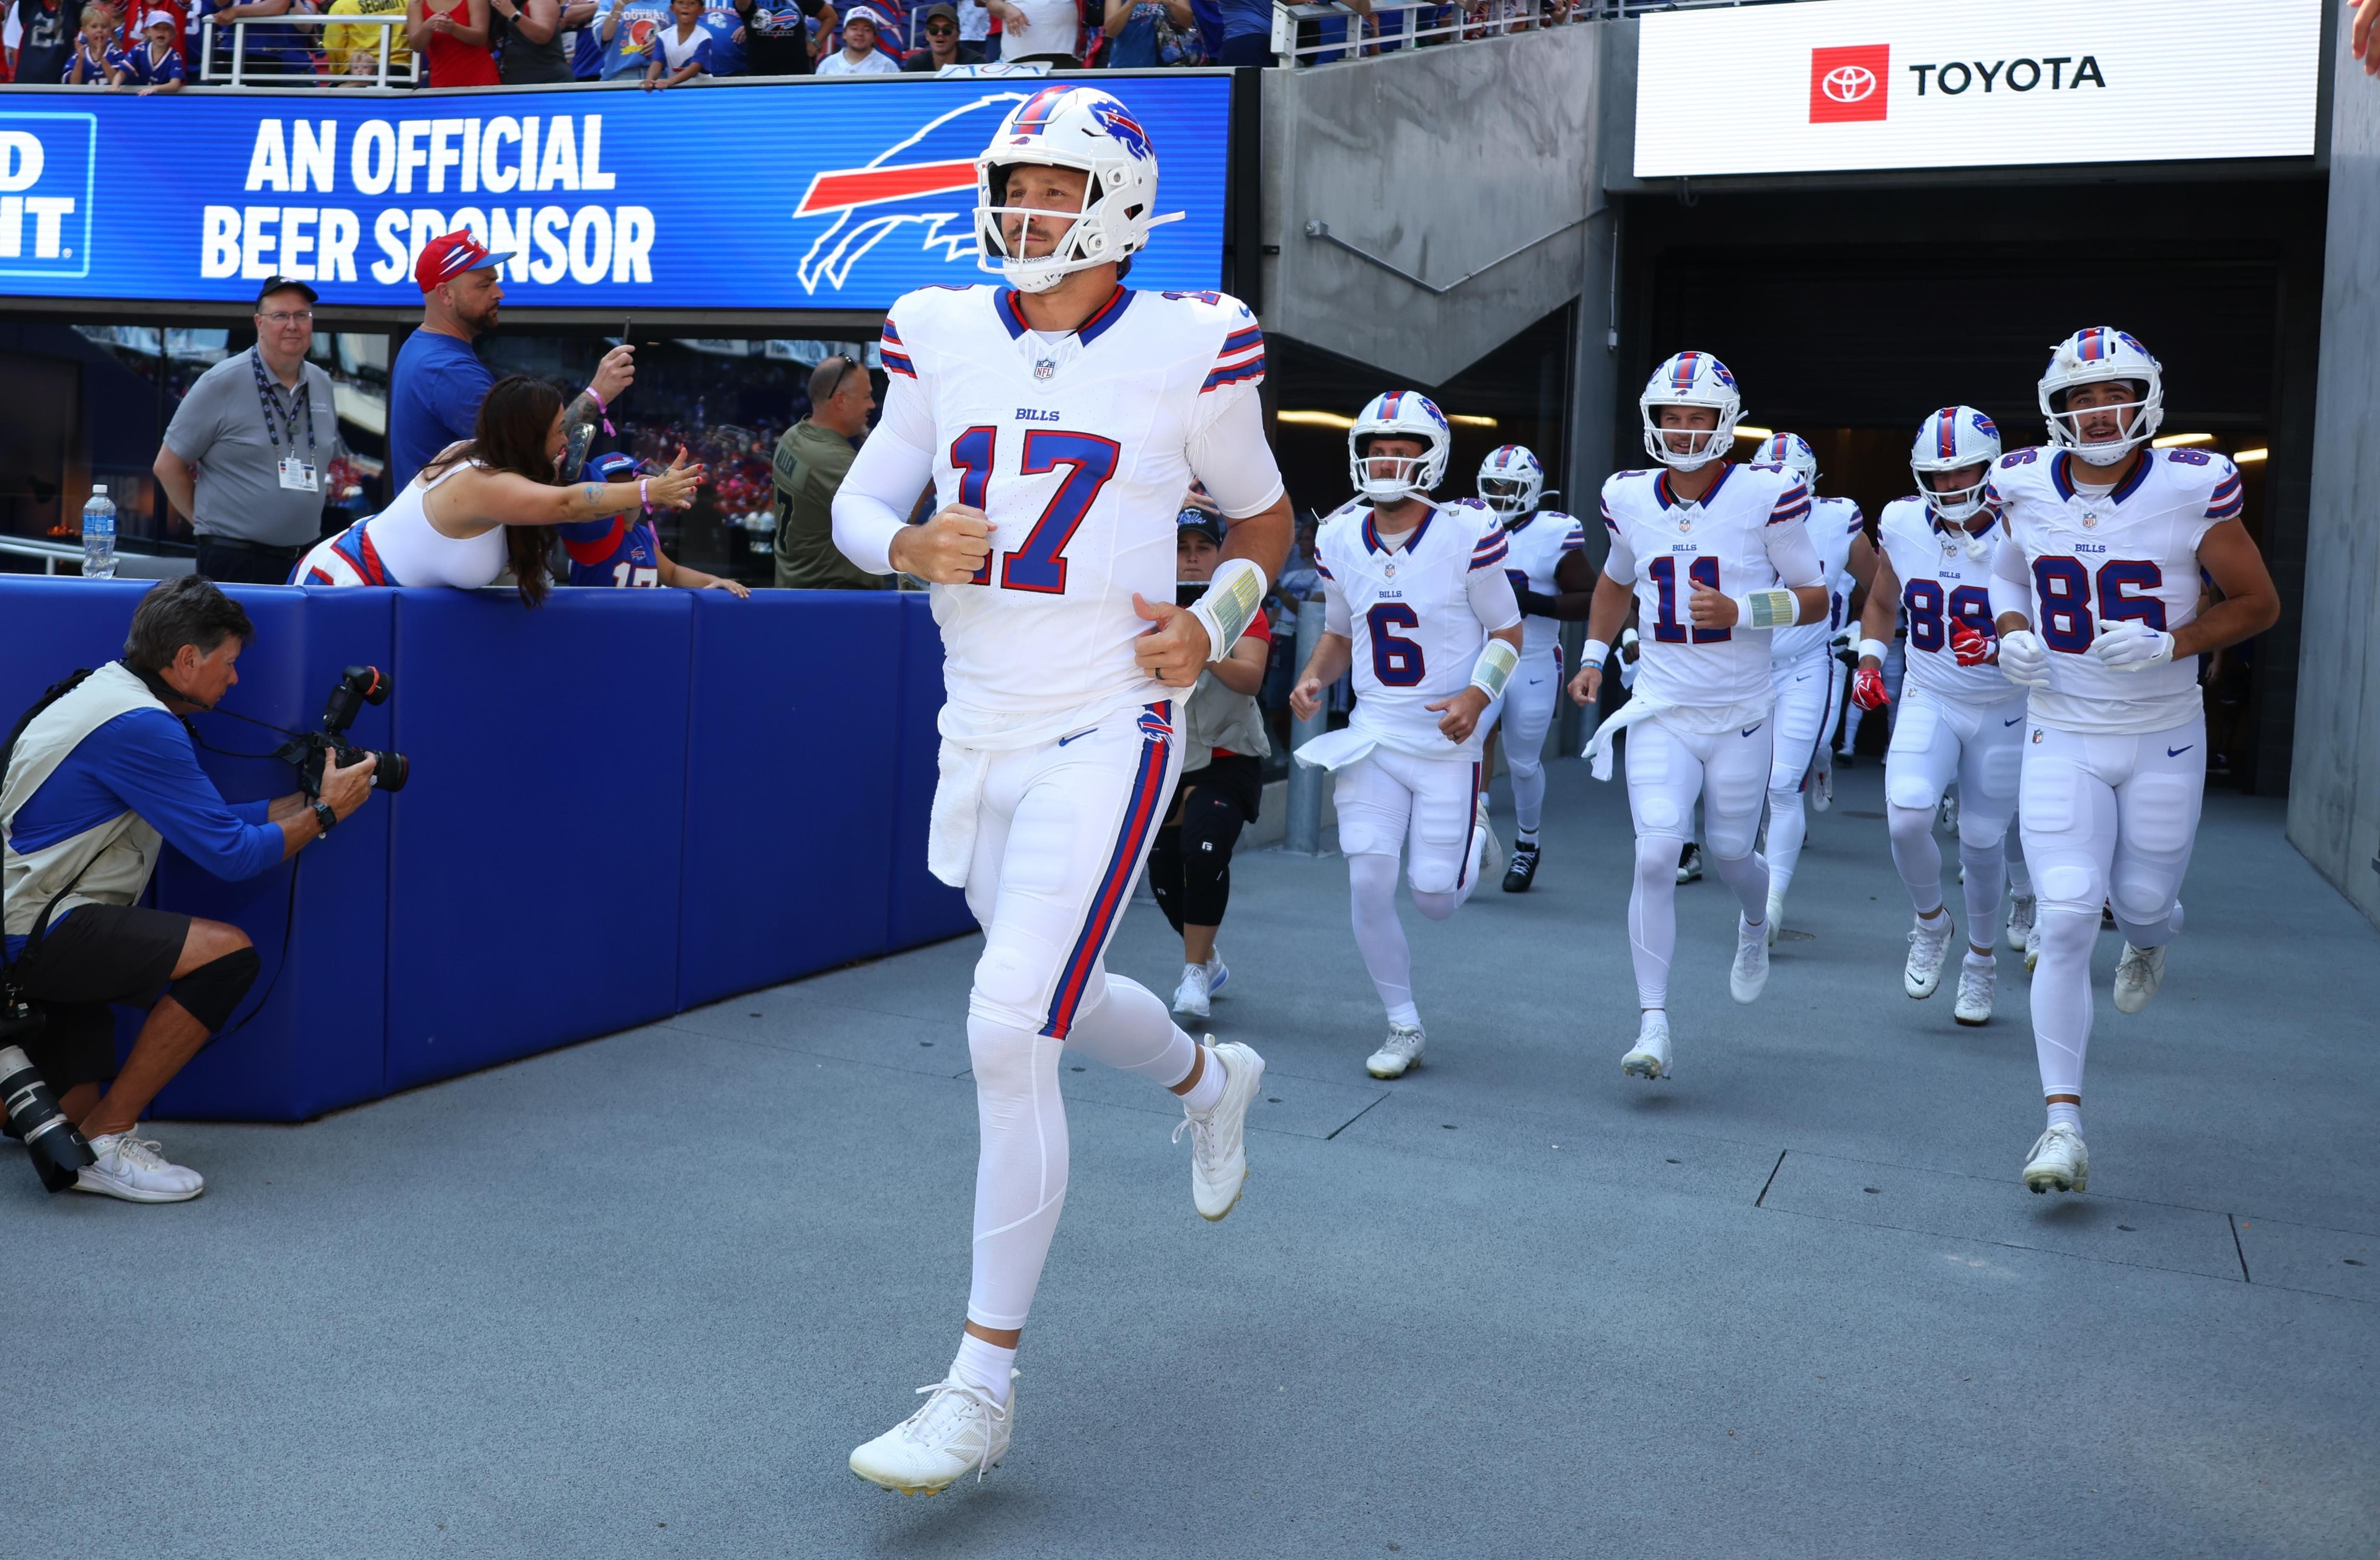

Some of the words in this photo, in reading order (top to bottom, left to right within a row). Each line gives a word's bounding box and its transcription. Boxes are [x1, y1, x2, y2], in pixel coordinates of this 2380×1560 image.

[941, 63, 1041, 77] MOM
[1909, 56, 2106, 96] TOYOTA
[245, 119, 337, 193] AN
[351, 114, 616, 195] OFFICIAL
[200, 205, 360, 283] BEER
[1036, 367, 1052, 377] NFL
[1015, 408, 1060, 421] BILLS
[776, 446, 798, 480] ALLEN
[950, 425, 1121, 595] 17
[1672, 544, 1698, 552] BILLS
[2074, 544, 2106, 553] BILLS
[1939, 571, 1961, 579] BILLS
[1378, 590, 1403, 598] BILLS
[1648, 555, 1732, 645] 11
[2032, 555, 2167, 654] 86
[1365, 602, 1426, 687] 6
